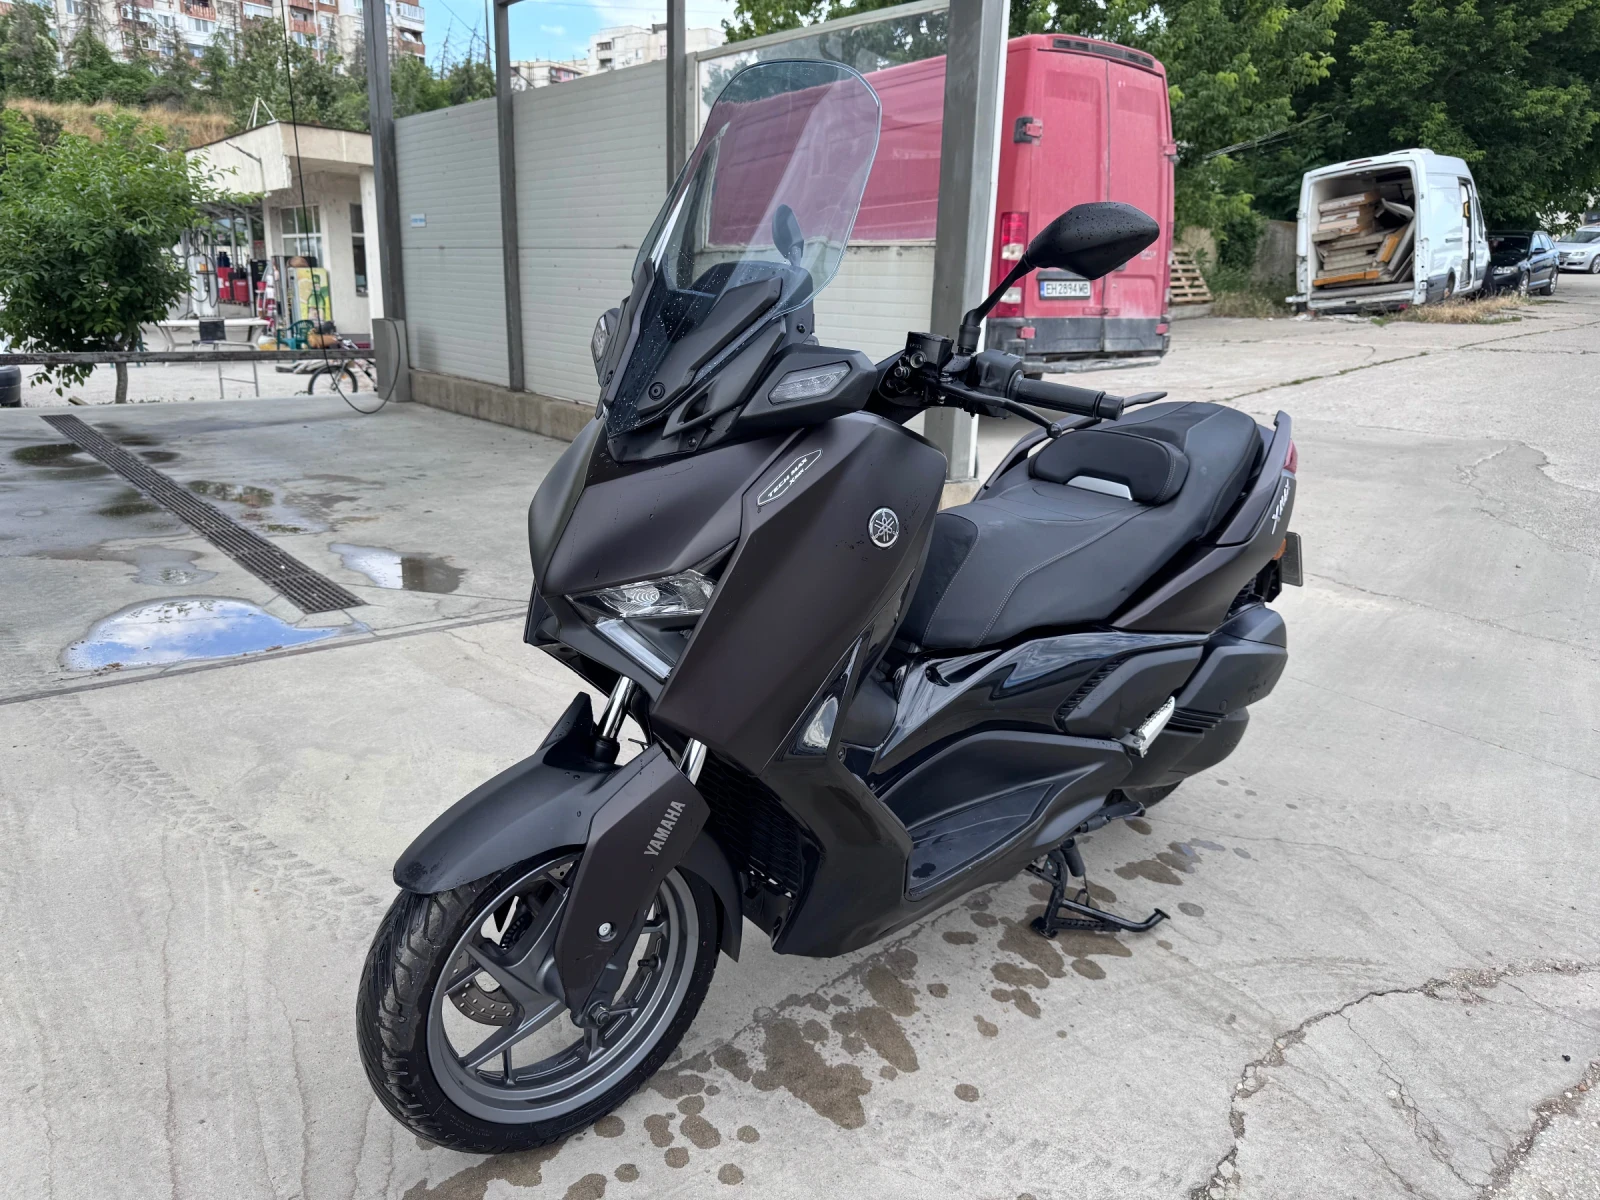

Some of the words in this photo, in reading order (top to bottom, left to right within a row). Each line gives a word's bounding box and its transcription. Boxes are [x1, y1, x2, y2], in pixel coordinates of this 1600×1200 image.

[768, 475, 790, 498] TECH
[790, 457, 808, 475] MAX
[644, 801, 686, 856] YAMAHA
